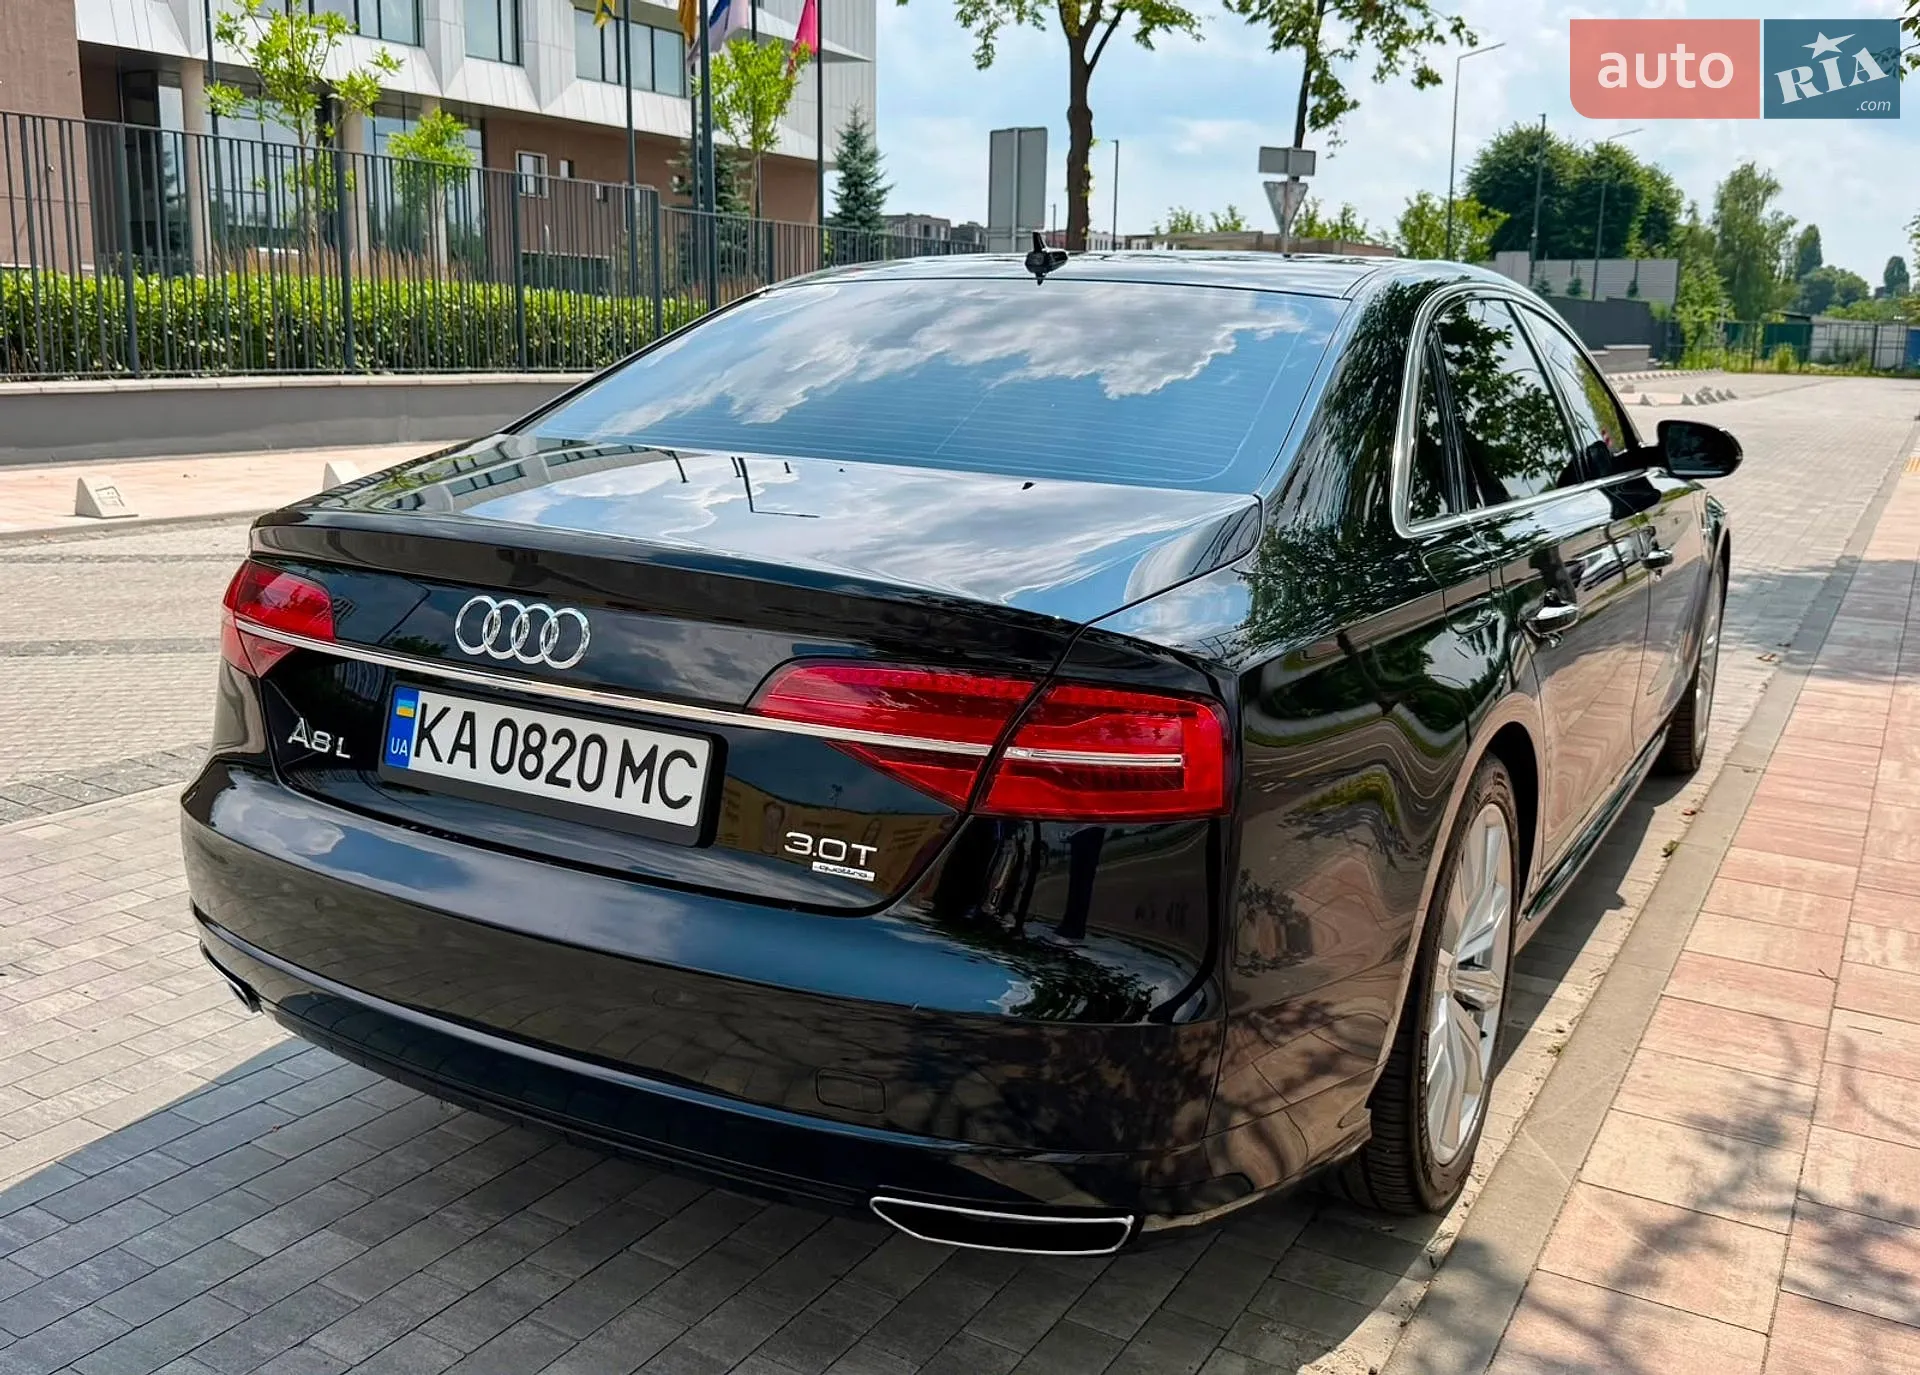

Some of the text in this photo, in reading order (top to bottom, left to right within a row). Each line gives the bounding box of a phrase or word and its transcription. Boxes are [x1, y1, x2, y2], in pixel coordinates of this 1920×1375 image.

[391, 736, 409, 757] UA
[414, 702, 699, 810] KA 0820 MC
[784, 831, 878, 866] 3.0T
